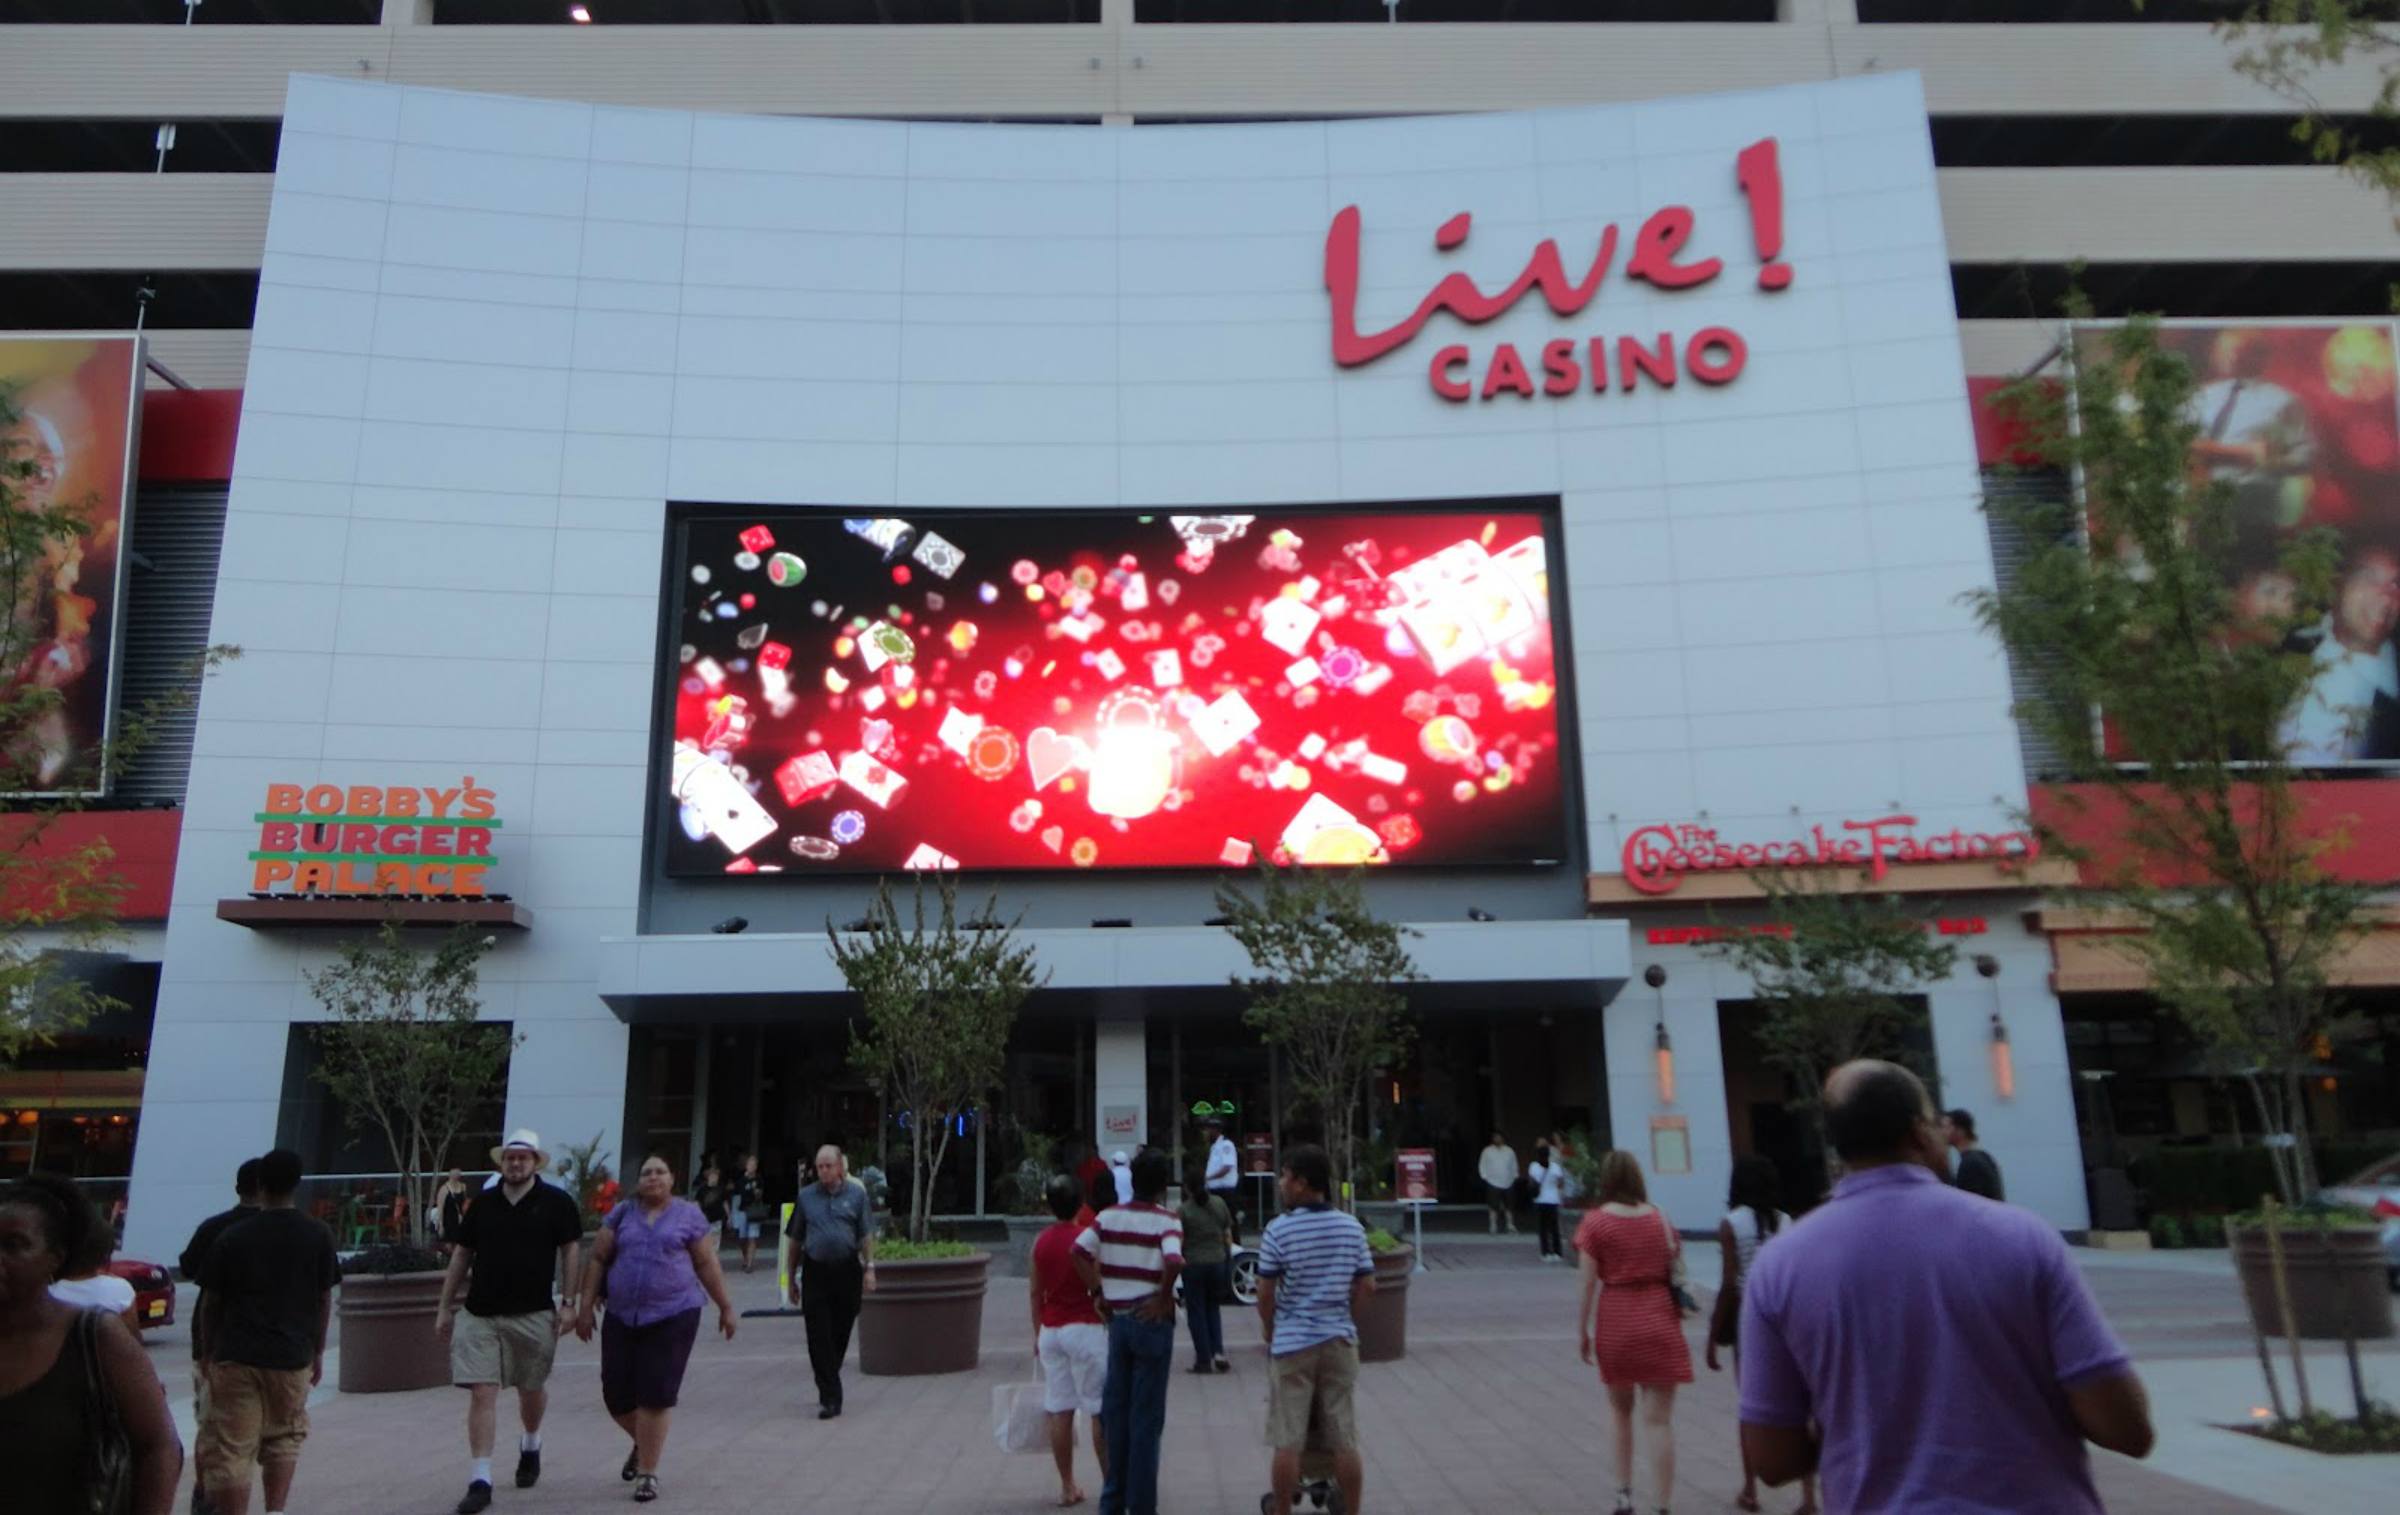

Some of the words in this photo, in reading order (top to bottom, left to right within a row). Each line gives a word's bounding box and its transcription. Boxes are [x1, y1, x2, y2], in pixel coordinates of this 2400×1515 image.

[1325, 137, 1794, 369] Live!
[1429, 326, 1748, 402] CASINO
[264, 776, 497, 820] BOBBY'S
[258, 821, 493, 857] BURGER
[1622, 821, 1862, 896] Cheesecake
[1842, 815, 2041, 882] Factory
[253, 859, 488, 895] PALACE
